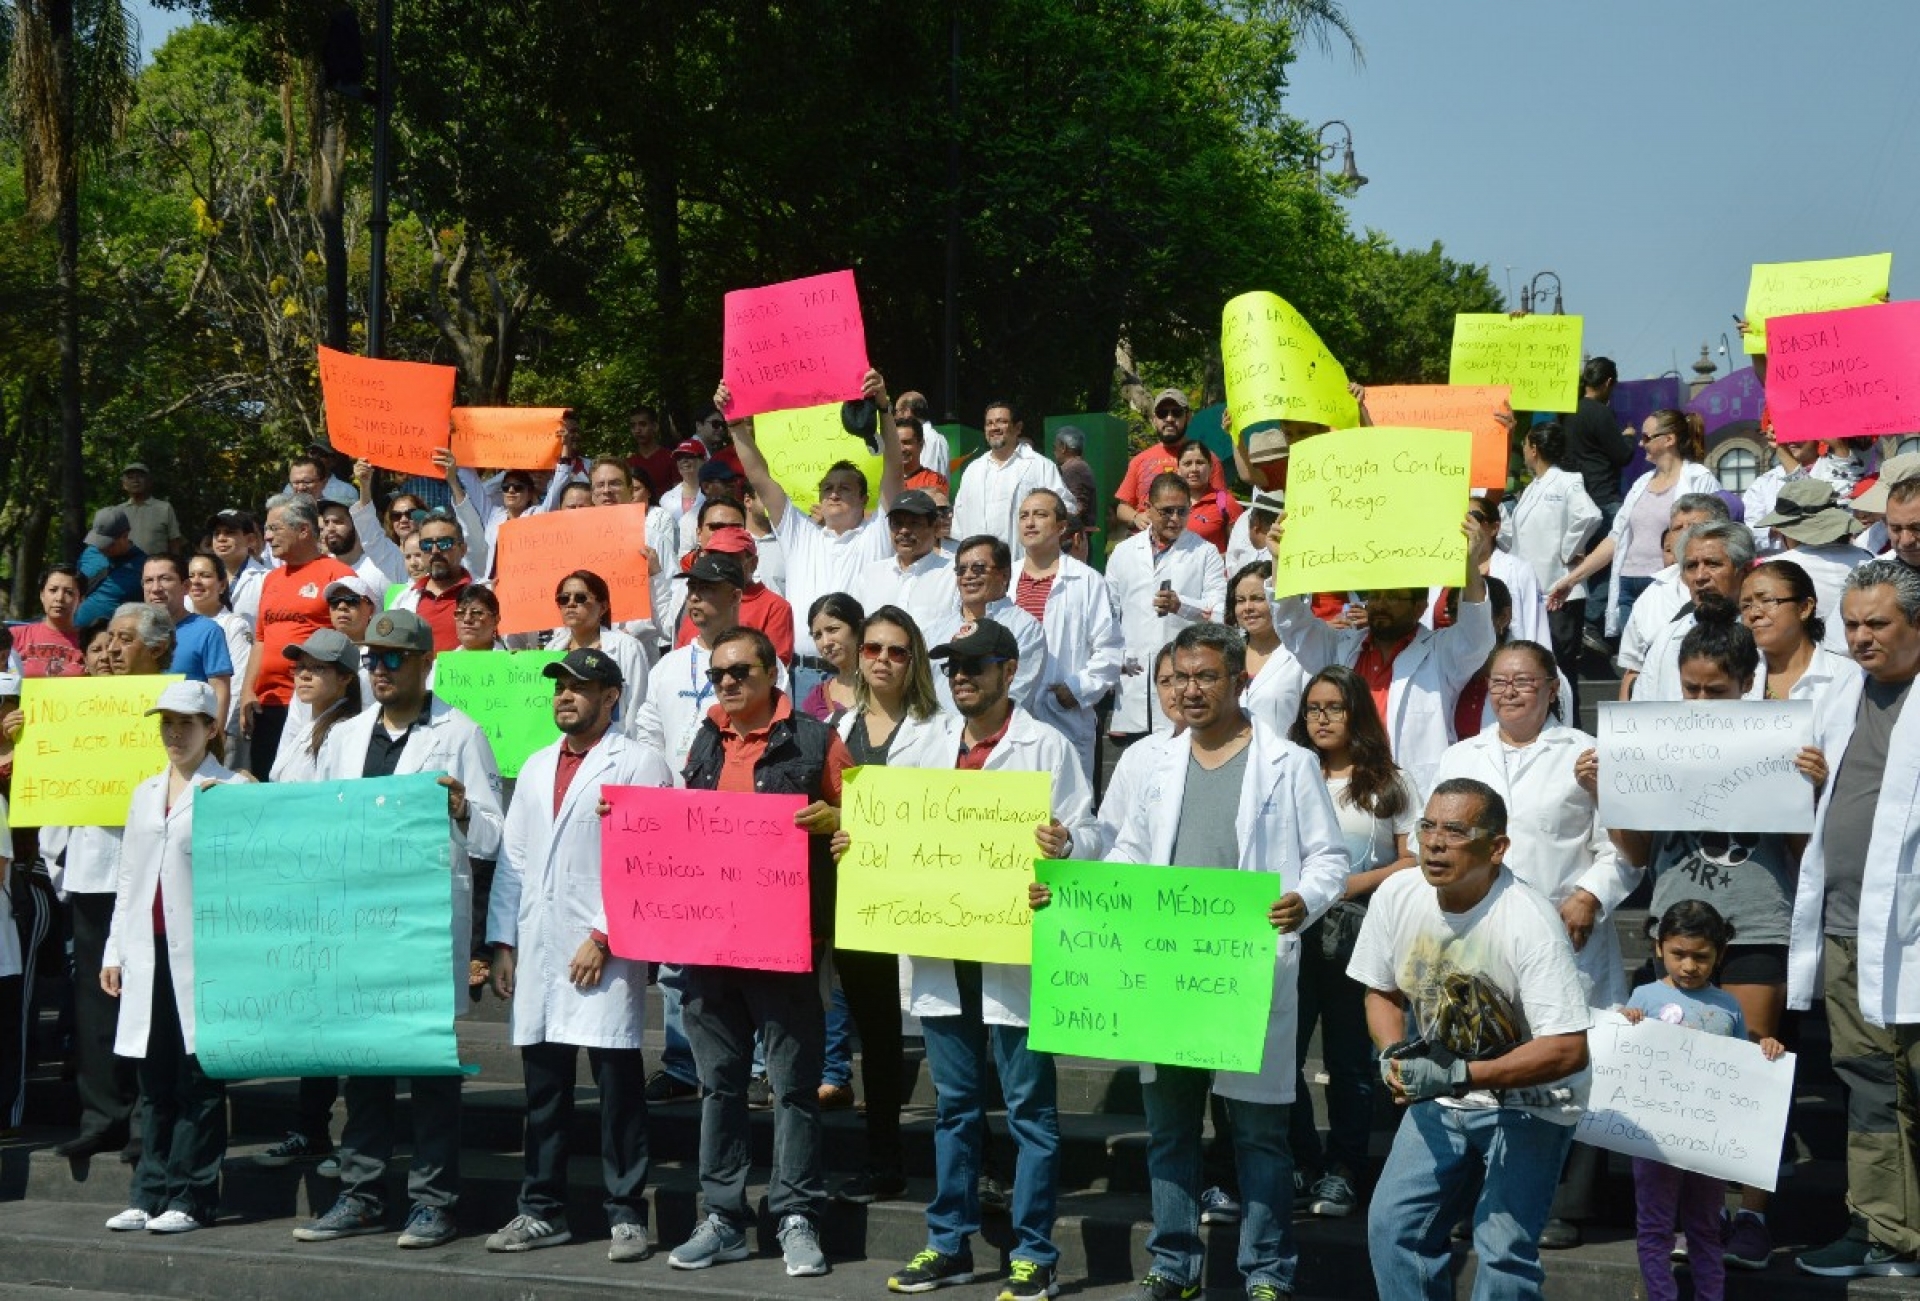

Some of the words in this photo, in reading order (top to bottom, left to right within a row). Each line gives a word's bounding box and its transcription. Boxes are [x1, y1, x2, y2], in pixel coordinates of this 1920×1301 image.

[1775, 364, 1799, 382] NO
[1810, 356, 1869, 377] SOMOS
[481, 673, 495, 686] LA
[1608, 706, 1638, 734] La
[1655, 708, 1735, 732] medicina
[1743, 714, 1766, 731] no
[1773, 714, 1793, 730] es
[37, 740, 60, 756] EL
[73, 735, 110, 752] ACTO
[1610, 745, 1645, 763] una
[853, 784, 886, 827] No
[896, 801, 910, 824] a
[687, 806, 783, 836] MÉDICOS
[625, 851, 705, 878] MÉDICOS
[720, 866, 742, 882] NO
[756, 867, 805, 887] SOMOS
[858, 841, 889, 869] Del
[912, 842, 962, 869] Acto
[858, 892, 1032, 927] #TodosSomosLui
[1045, 880, 1132, 912] NINGÚN
[1157, 884, 1236, 916] MÉDICO
[355, 905, 398, 940] para
[632, 899, 738, 929] ASESINOS!
[1059, 922, 1122, 952] ACTÚA
[1145, 938, 1177, 952] CON
[1050, 970, 1089, 988] CION
[1120, 969, 1148, 990] DE
[1176, 974, 1239, 996] HACER
[1051, 1005, 1119, 1037] DAÑO!
[1608, 1022, 1670, 1070] Tengo
[1680, 1038, 1693, 1066] 4
[1610, 1085, 1717, 1123] Asesinos
[1704, 1087, 1721, 1100] no
[1728, 1091, 1761, 1111] son
